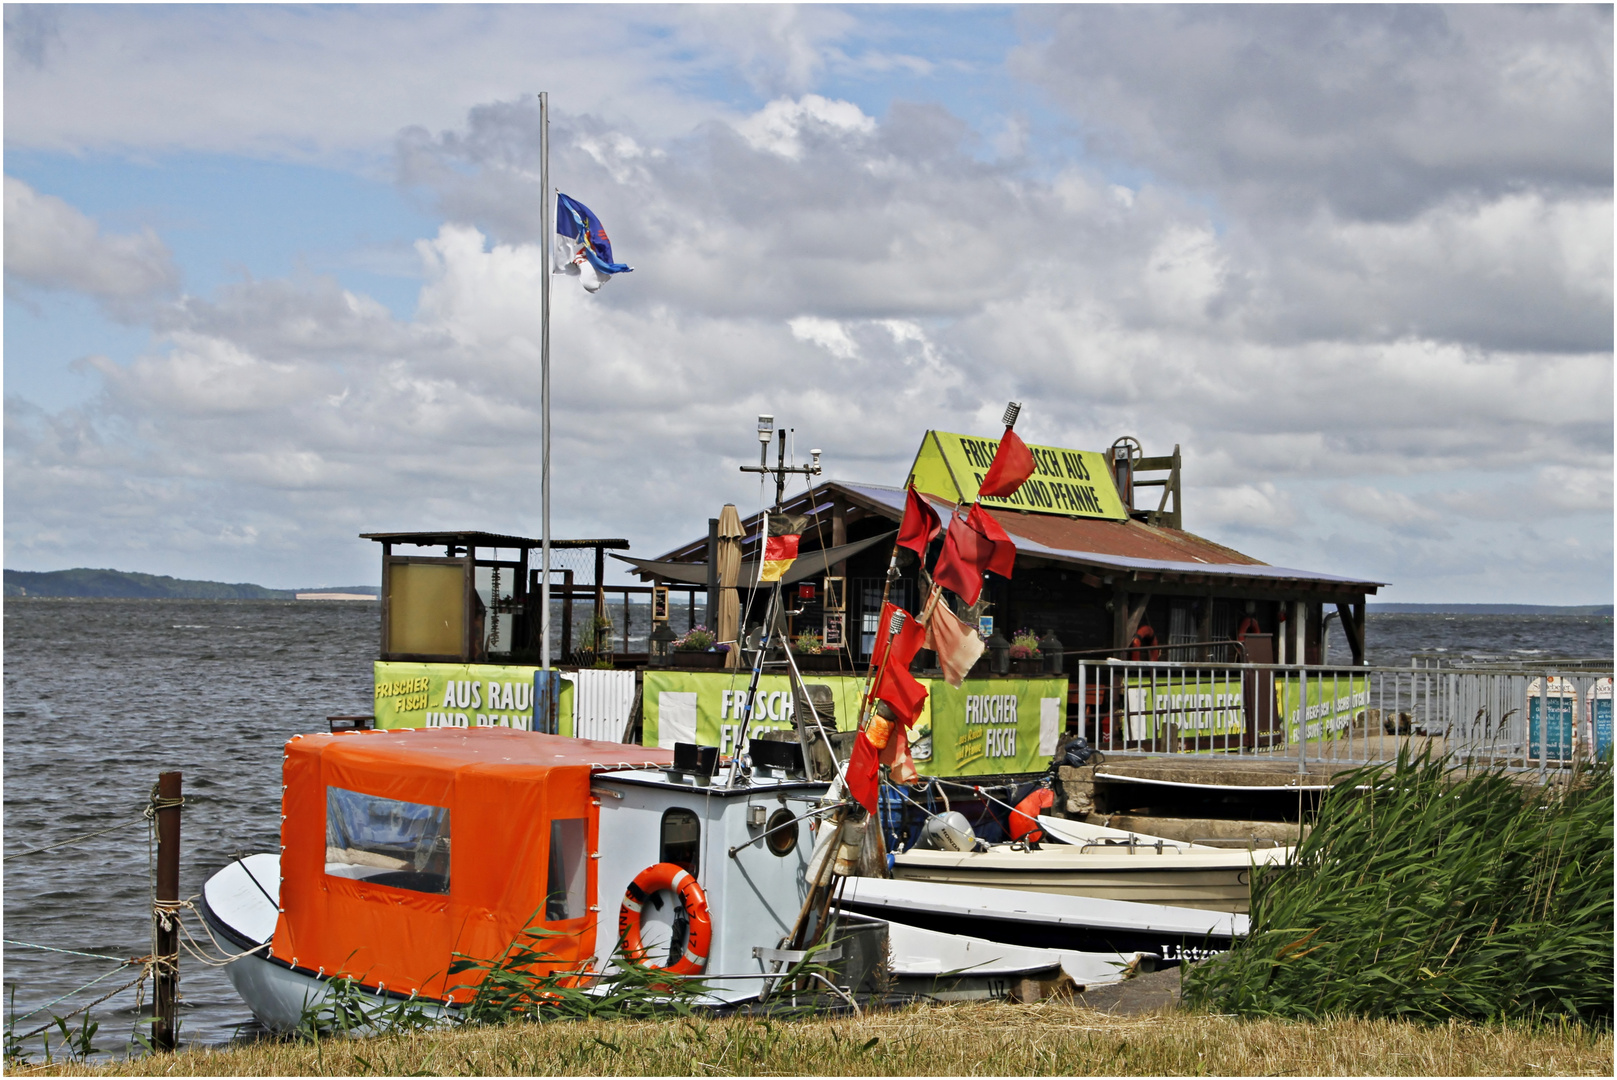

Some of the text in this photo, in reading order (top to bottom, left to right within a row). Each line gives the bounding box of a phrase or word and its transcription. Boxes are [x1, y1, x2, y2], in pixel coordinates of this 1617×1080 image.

[1029, 448, 1064, 477] ISCH
[1061, 452, 1090, 481] AUS
[1022, 479, 1053, 508] UND
[1049, 482, 1104, 513] PFANNE
[375, 676, 429, 699] FRISCHER
[443, 680, 482, 709] AUS
[395, 693, 429, 713] FISCH
[965, 694, 1017, 724] FRISCHER
[985, 728, 1017, 757] FISCH
[941, 827, 960, 852] HONDA
[689, 931, 698, 949] 17
[1161, 944, 1229, 961] Lietzo
